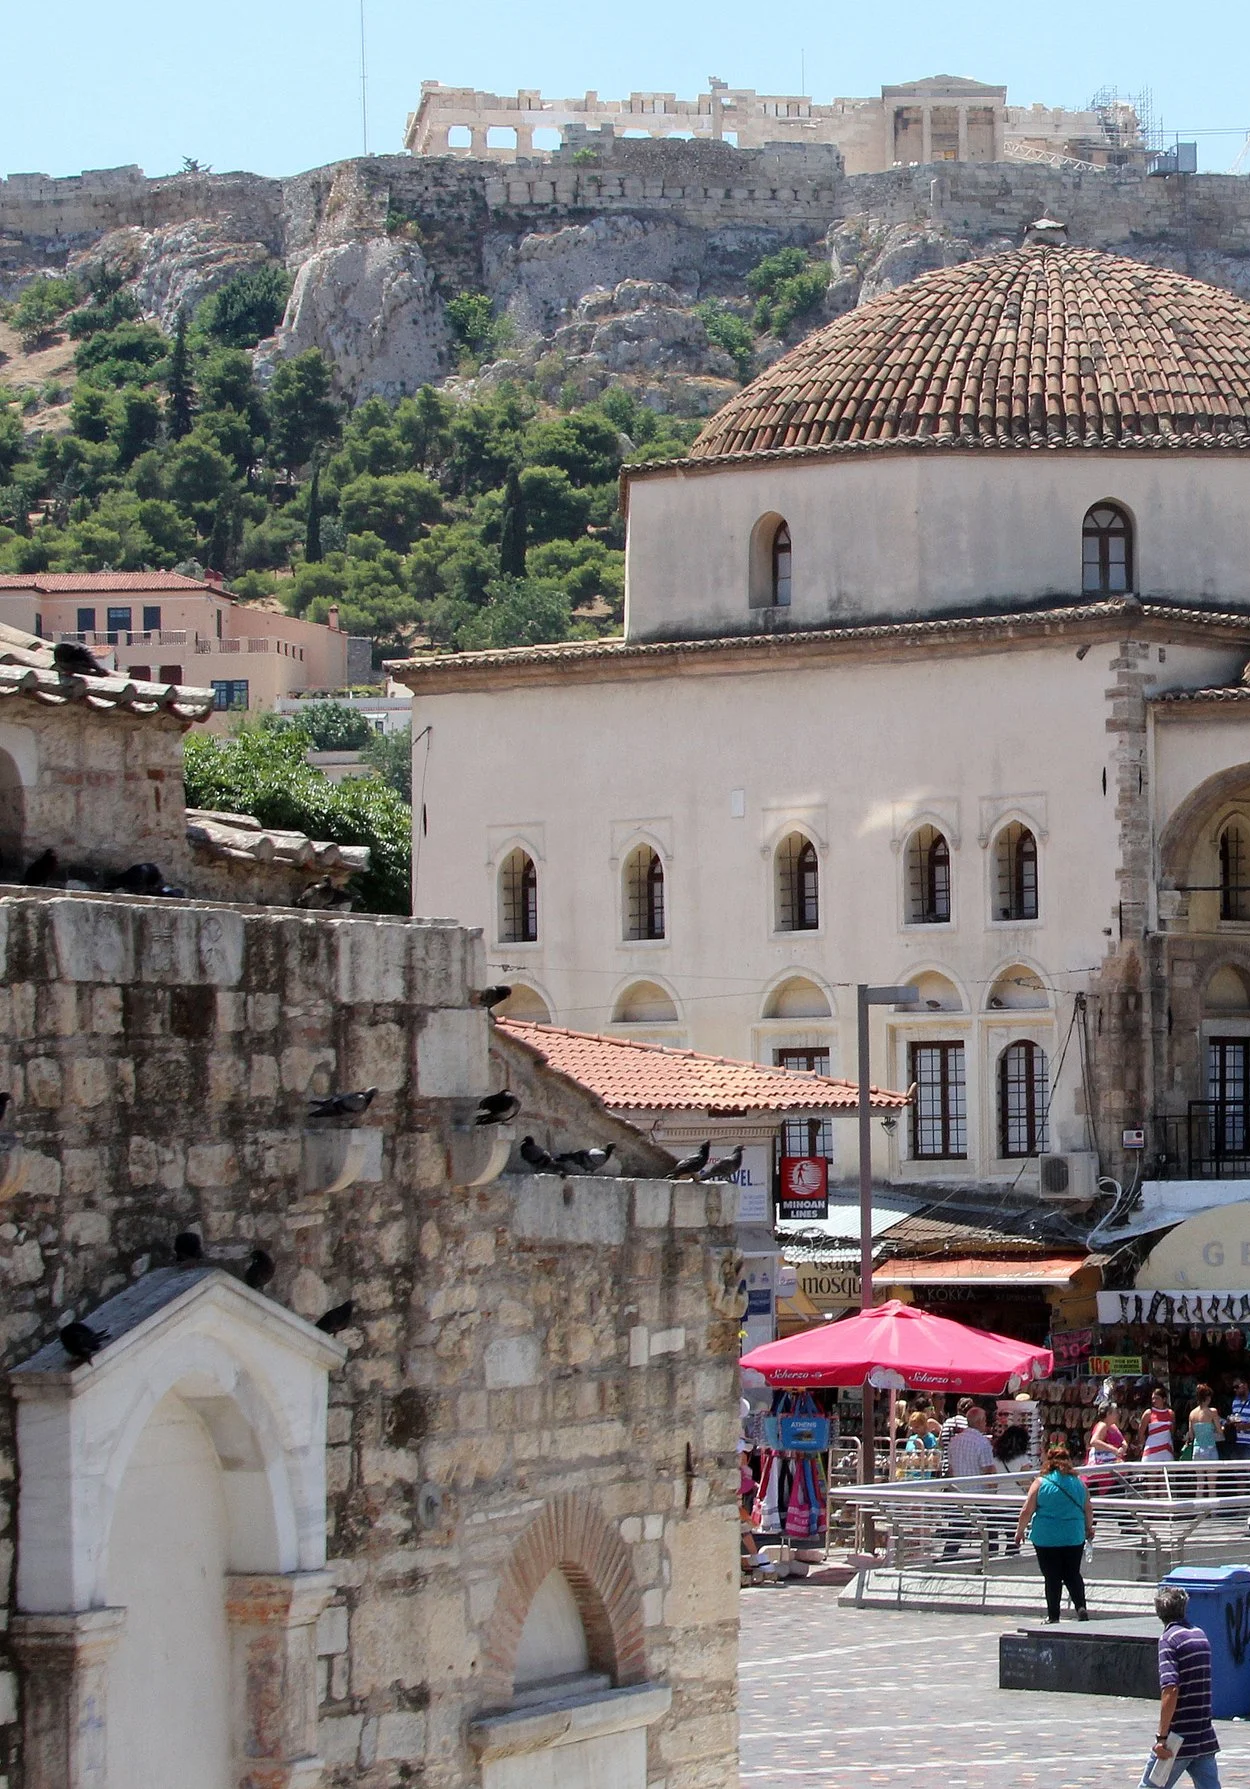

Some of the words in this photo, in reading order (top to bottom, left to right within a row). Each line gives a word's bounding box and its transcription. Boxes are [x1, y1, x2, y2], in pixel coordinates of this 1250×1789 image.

[783, 1200, 825, 1209] MINOAN
[790, 1209, 818, 1218] LINES
[802, 1276, 862, 1298] mosqu
